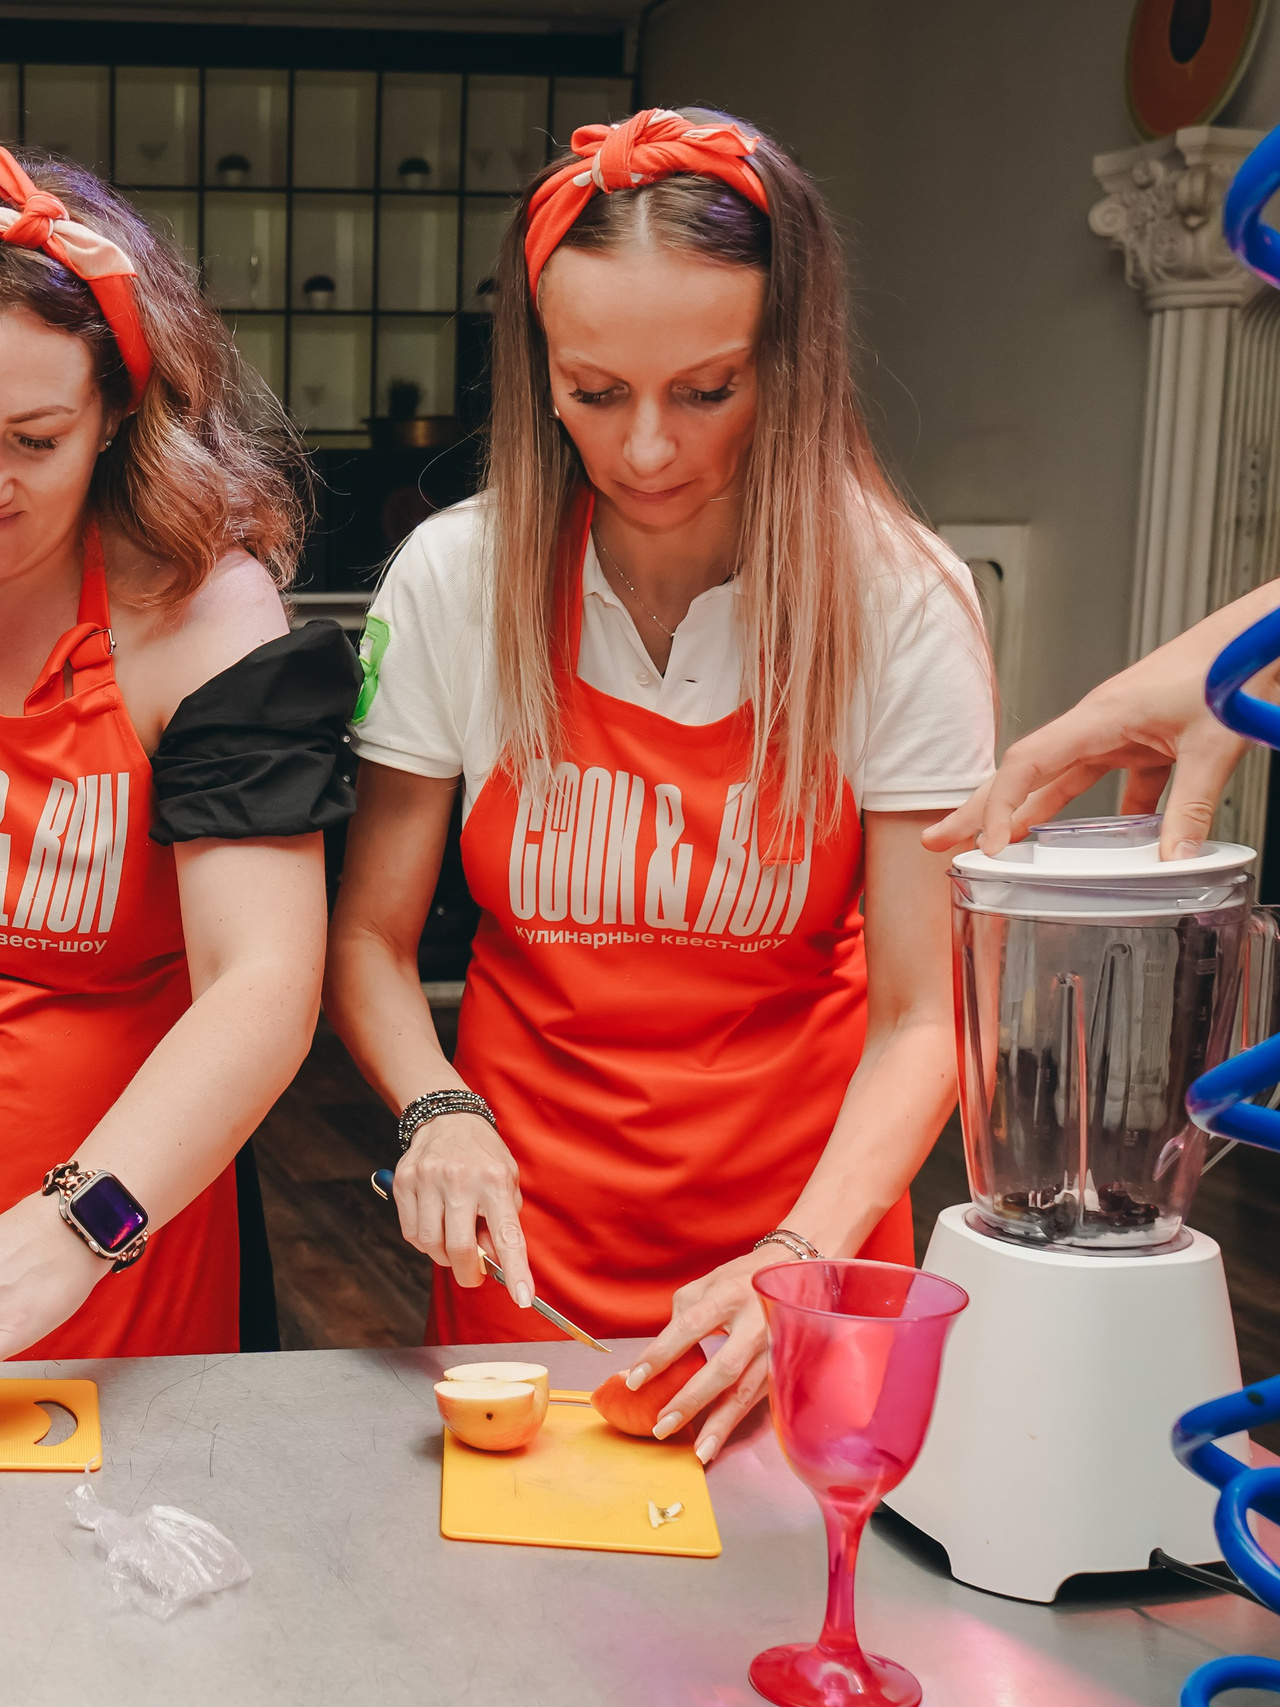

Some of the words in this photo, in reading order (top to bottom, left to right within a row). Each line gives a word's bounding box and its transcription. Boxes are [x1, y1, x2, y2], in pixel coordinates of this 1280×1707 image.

[12, 772, 130, 933] RUN
[508, 757, 645, 926] COOK
[644, 783, 693, 932] &
[515, 925, 654, 949] кулинарные
[661, 936, 788, 953] квест-шоу
